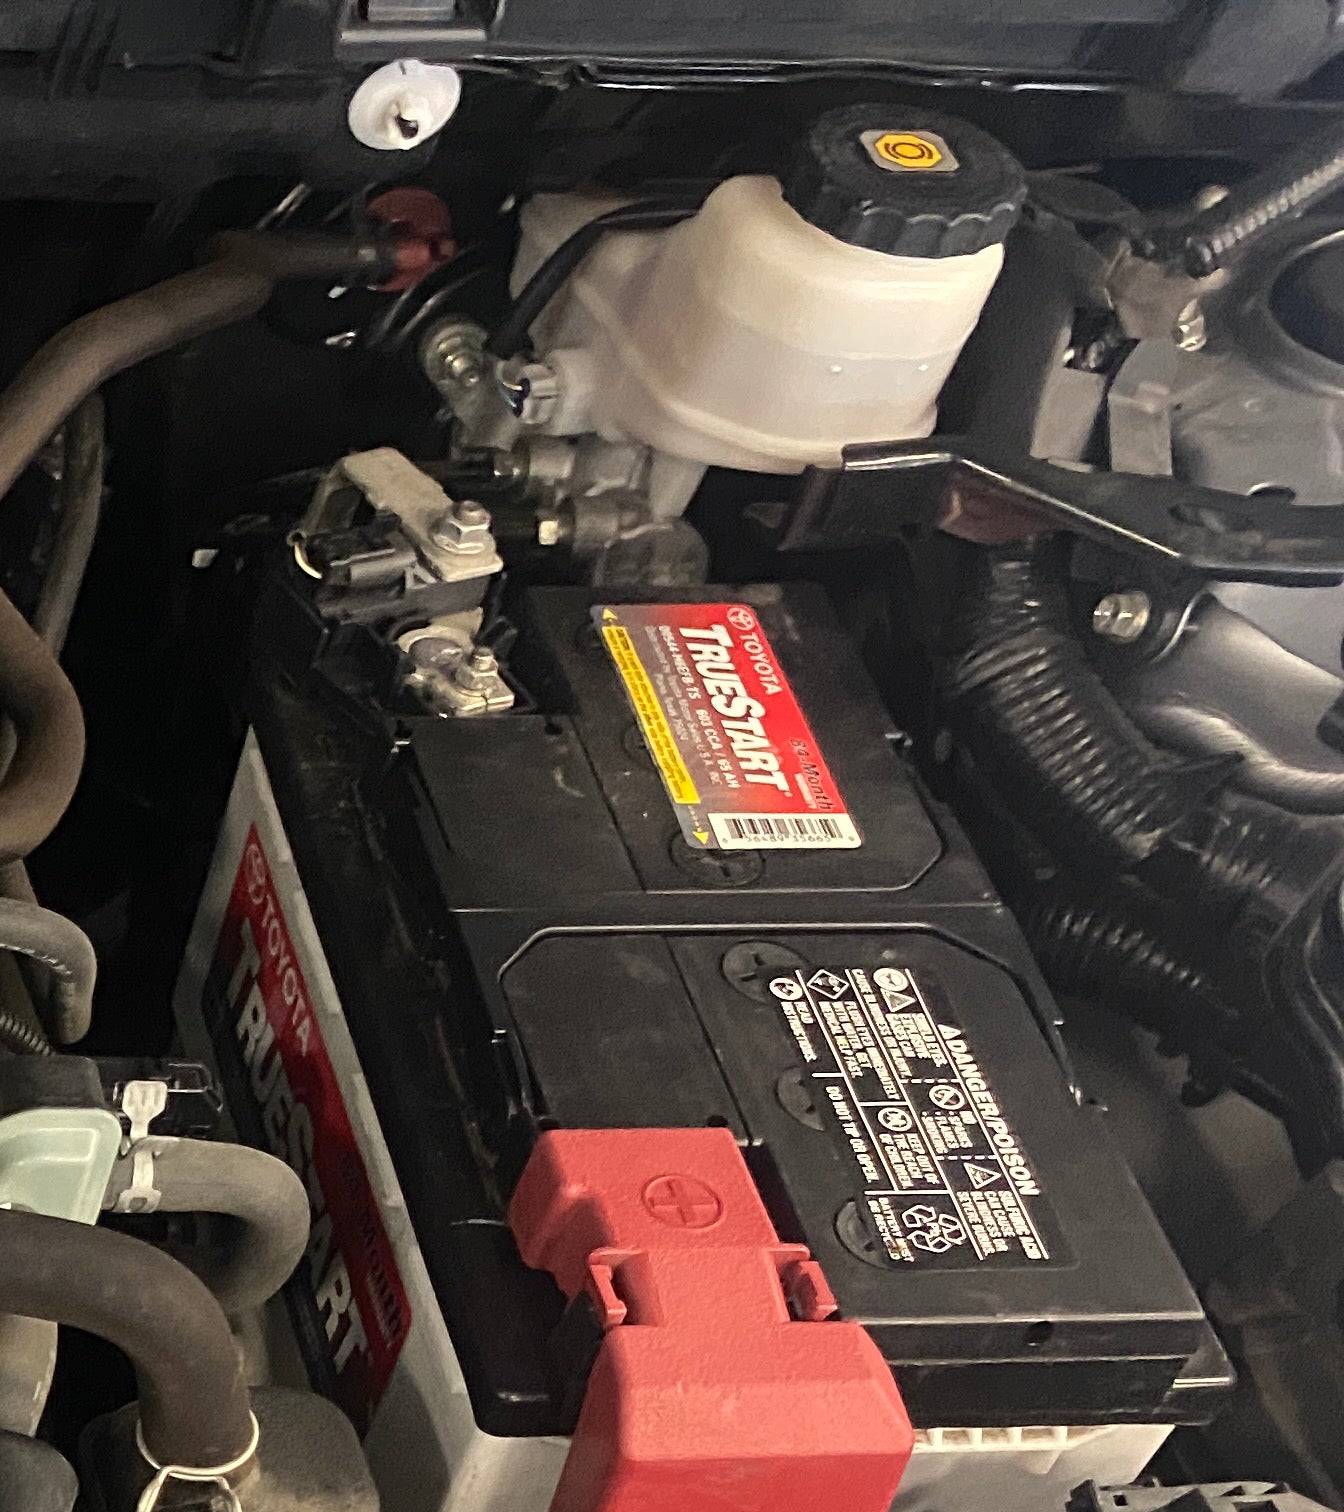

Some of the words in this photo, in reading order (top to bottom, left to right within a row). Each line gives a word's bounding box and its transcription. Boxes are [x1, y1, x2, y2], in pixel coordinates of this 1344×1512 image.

[739, 633, 780, 695] TOYOTA
[702, 728, 724, 749] CCA
[721, 772, 741, 788] AH
[258, 904, 312, 1056] TOYOTA
[824, 1086, 844, 1100] DO
[831, 1101, 853, 1120] NOT
[840, 1122, 861, 1137] TIP
[944, 1039, 1040, 1194] DANGER/POISON
[847, 1138, 867, 1152] OR
